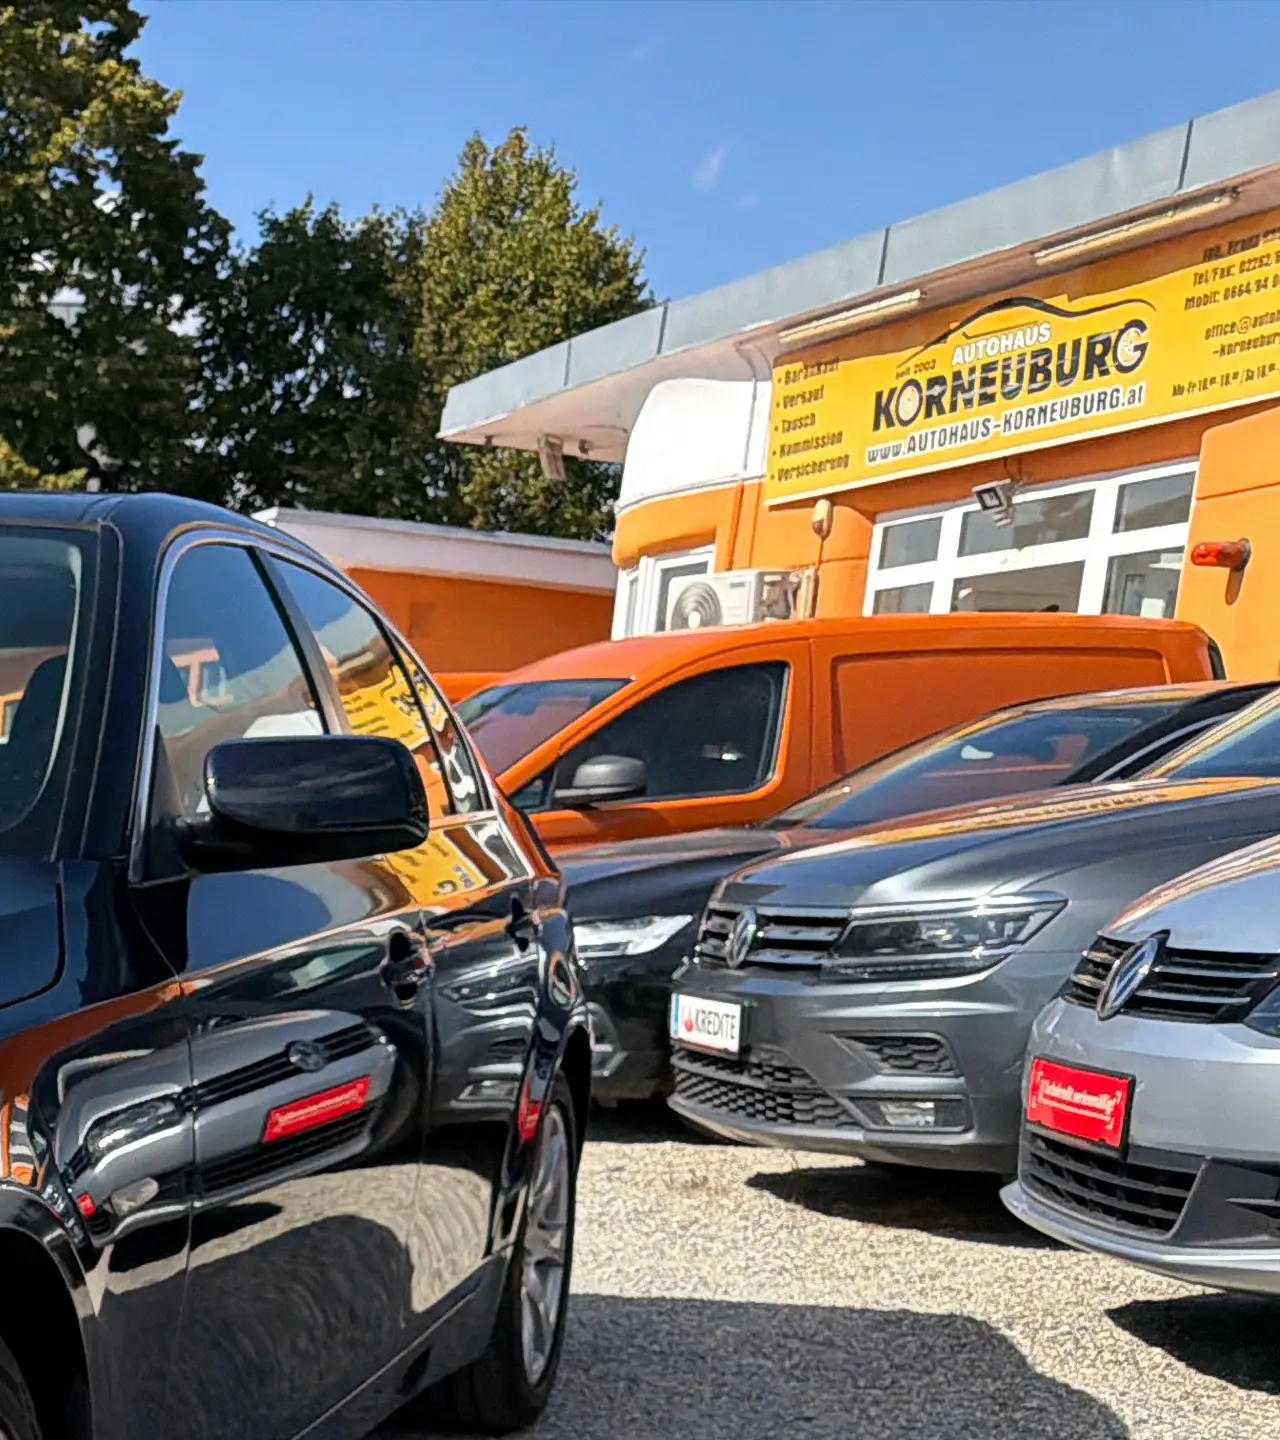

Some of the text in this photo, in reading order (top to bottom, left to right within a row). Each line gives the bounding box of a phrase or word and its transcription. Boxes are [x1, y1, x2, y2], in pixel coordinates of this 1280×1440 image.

[951, 322, 1052, 367] AUTOHAUS
[872, 318, 1150, 433] KORNEUBURG
[782, 384, 825, 410] Verkauf
[780, 412, 817, 435] Tausch
[866, 384, 1145, 464] www.AUTOHAUS-KORNEUBURG.at
[778, 430, 844, 459] Kommission
[776, 453, 851, 483] Versicherung
